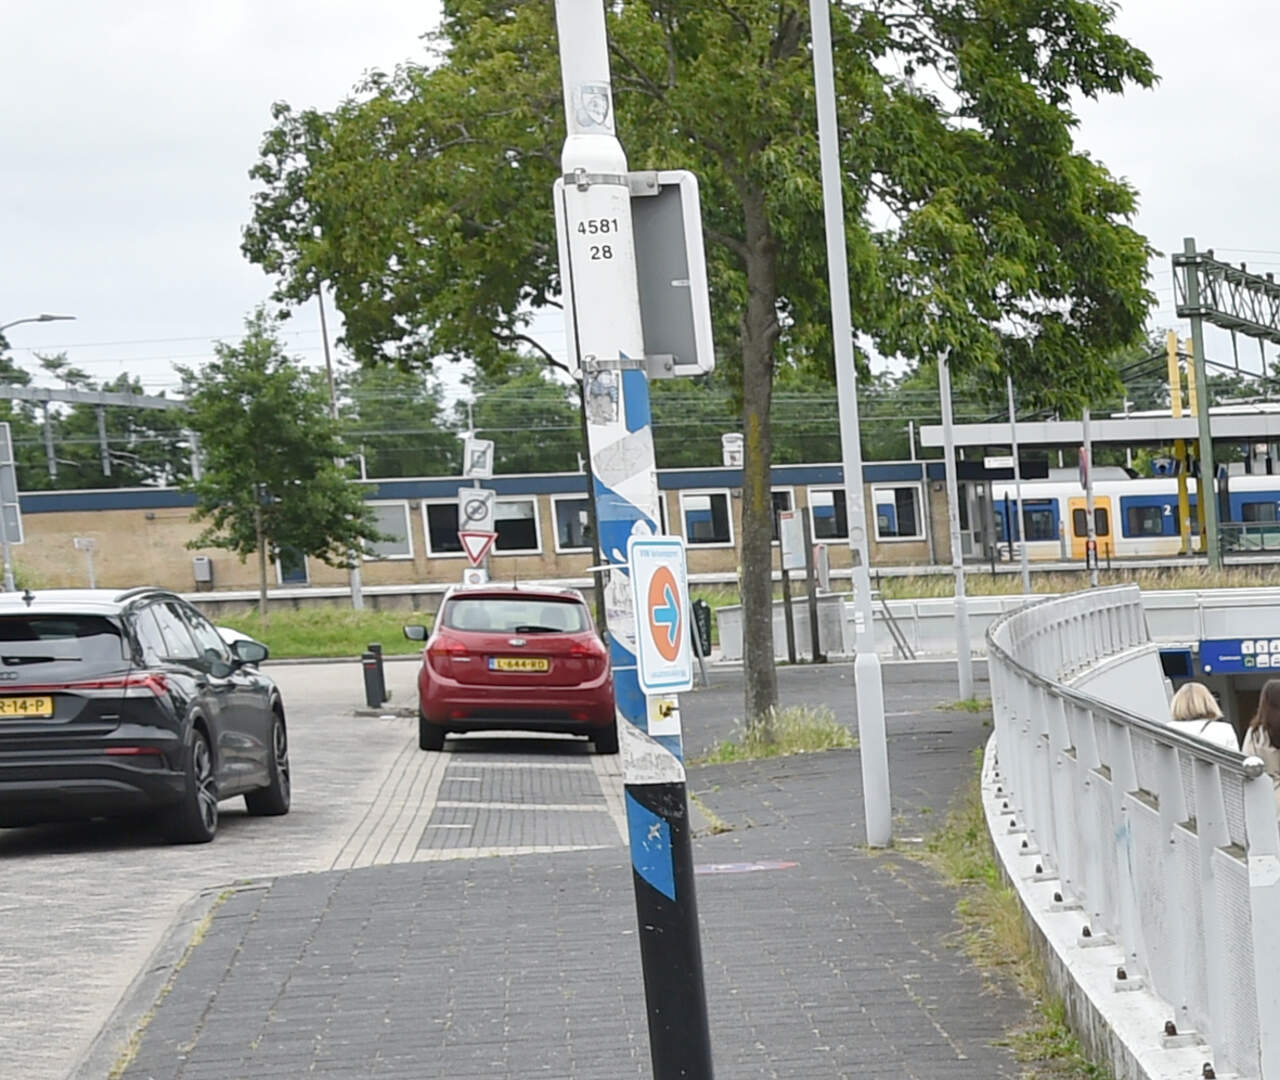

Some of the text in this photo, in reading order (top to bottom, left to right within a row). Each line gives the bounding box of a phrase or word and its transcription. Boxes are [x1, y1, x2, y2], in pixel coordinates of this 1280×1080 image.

[577, 218, 618, 235] 4581
[590, 245, 613, 260] 28
[1163, 504, 1172, 516] 2
